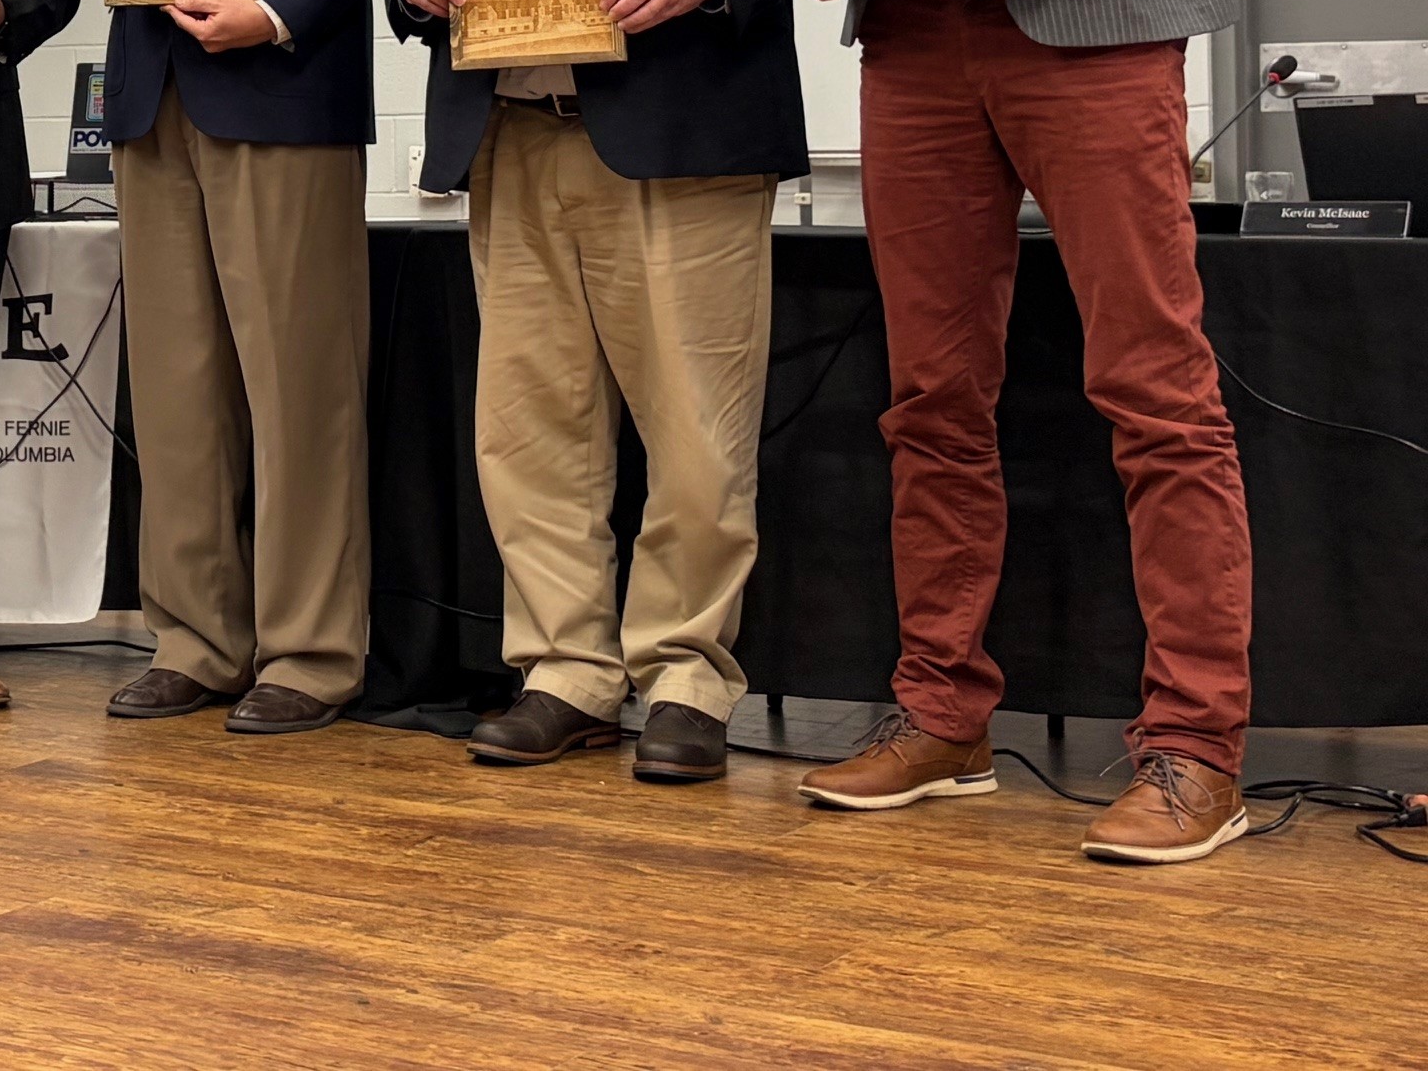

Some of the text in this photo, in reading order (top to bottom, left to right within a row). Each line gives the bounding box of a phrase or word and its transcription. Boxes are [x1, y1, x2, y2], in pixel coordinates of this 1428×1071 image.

[1281, 208, 1370, 218] Kevin McIsaac
[5, 420, 71, 436] FERNIE
